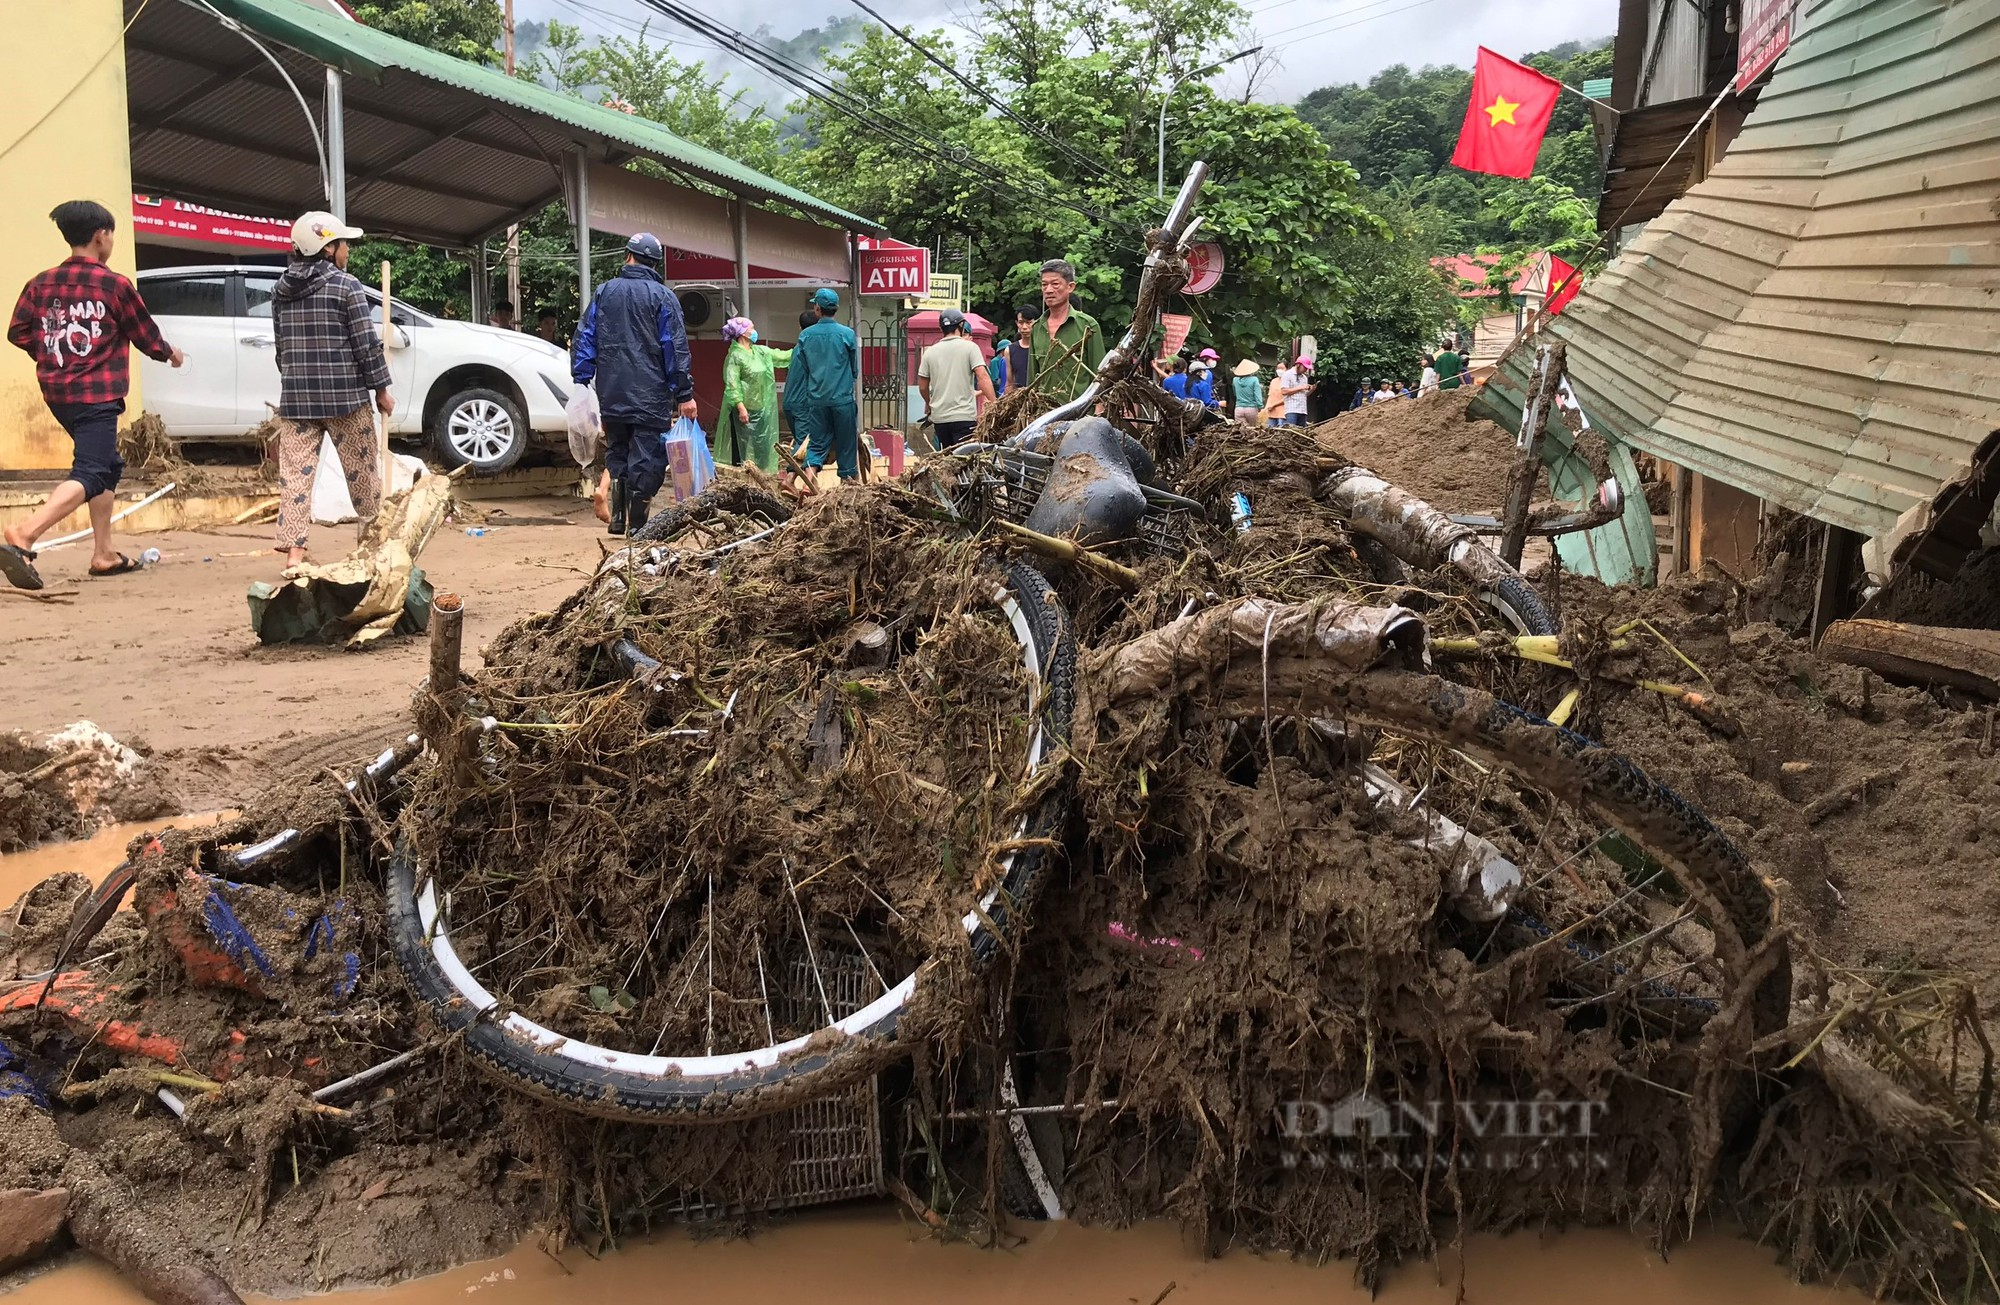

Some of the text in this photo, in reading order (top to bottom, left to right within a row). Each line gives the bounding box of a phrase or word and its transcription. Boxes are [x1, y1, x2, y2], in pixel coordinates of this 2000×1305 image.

[875, 255, 918, 264] AGRIBANK
[867, 267, 919, 288] ATM
[69, 300, 106, 320] MAD
